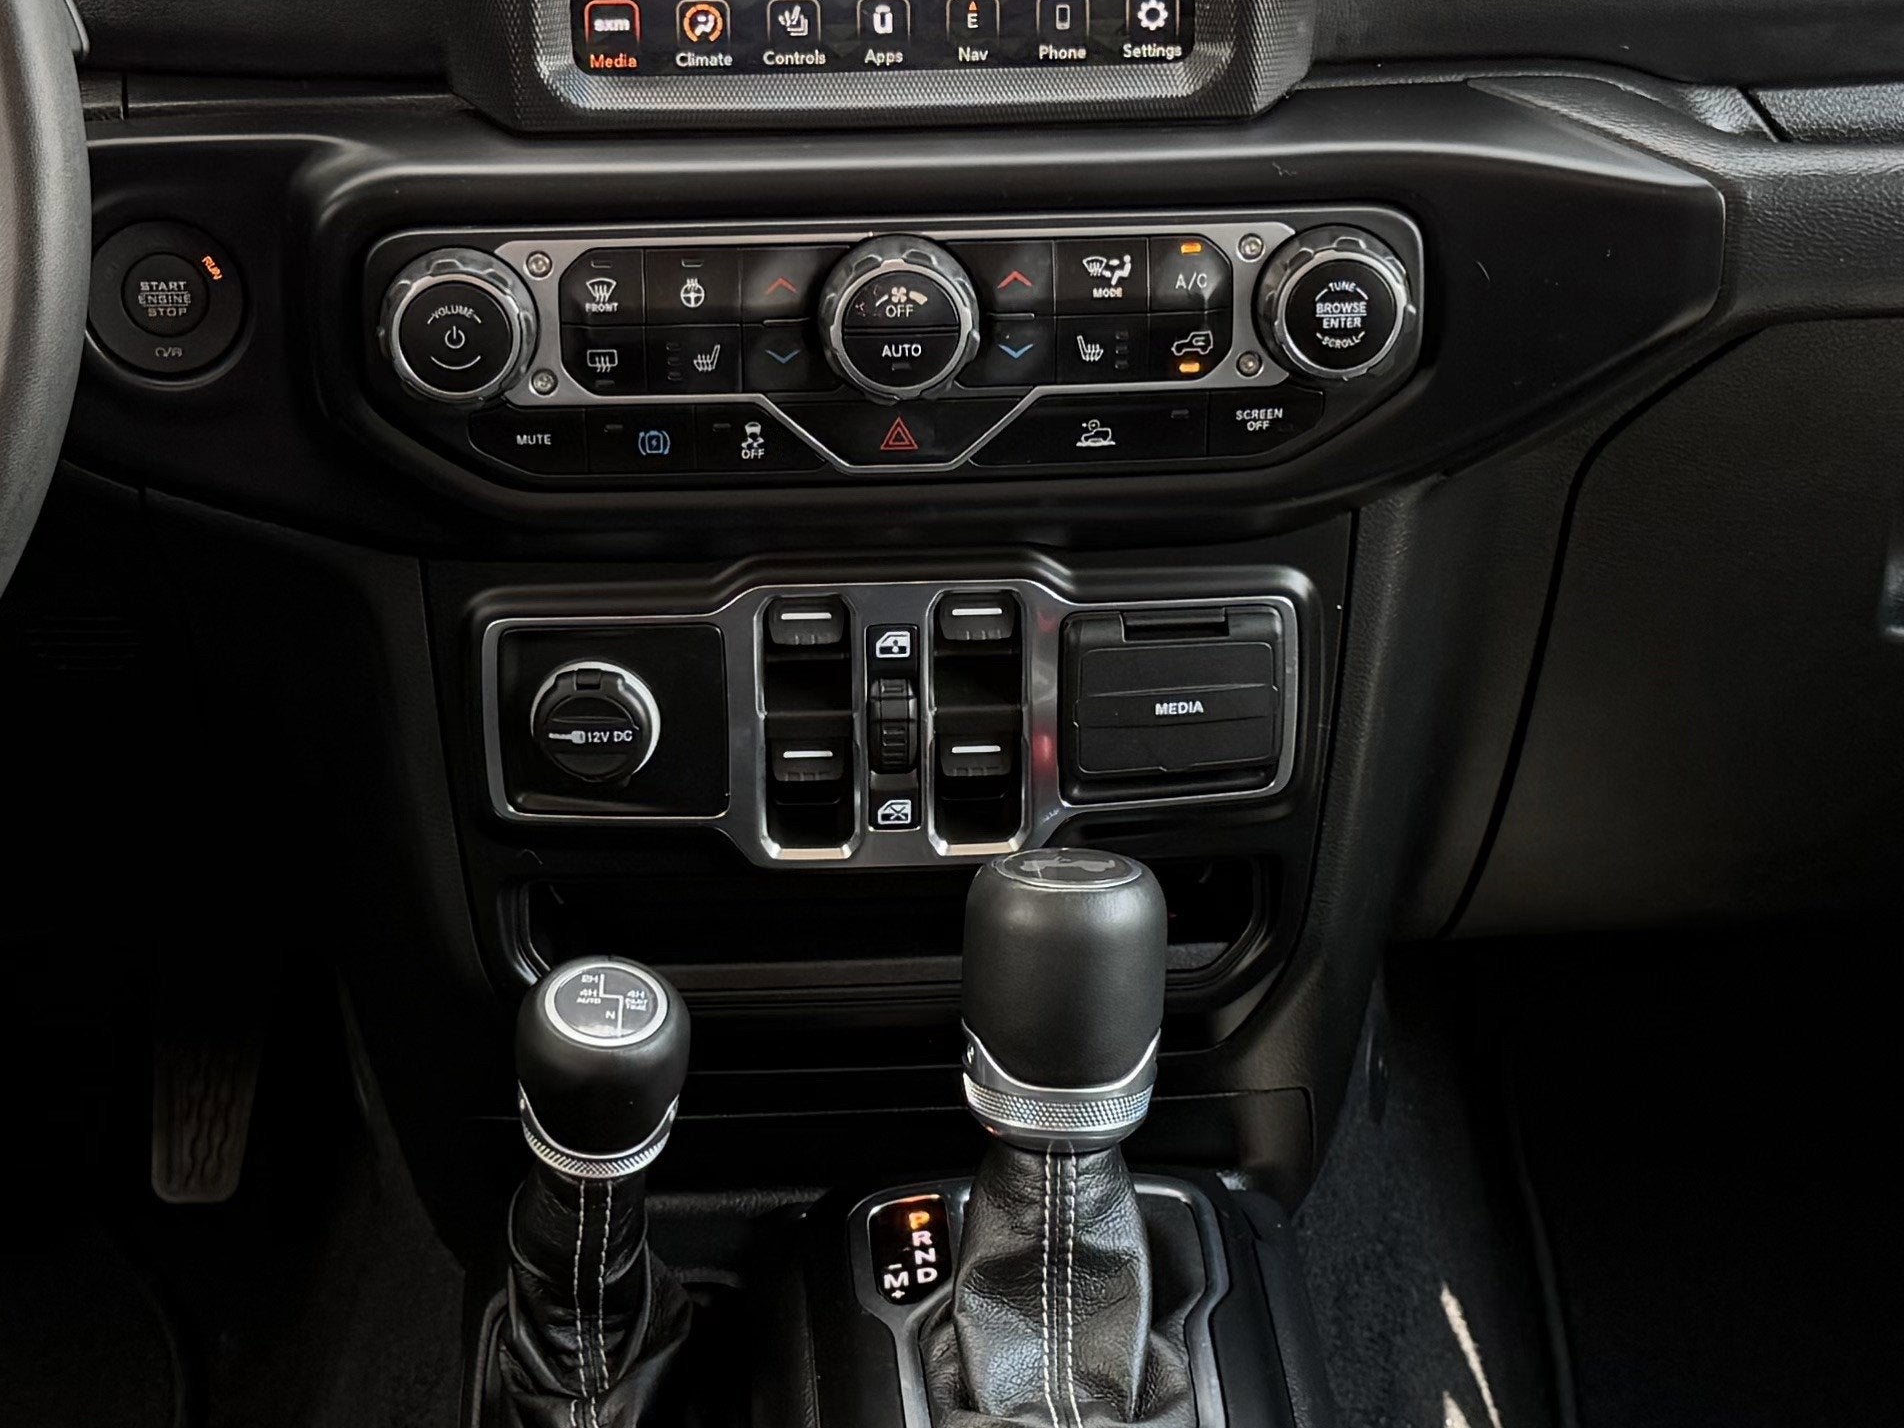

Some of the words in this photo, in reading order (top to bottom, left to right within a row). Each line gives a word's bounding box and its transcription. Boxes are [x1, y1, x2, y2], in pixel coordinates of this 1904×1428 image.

[675, 51, 733, 67] Climate
[763, 49, 826, 66] Controls
[864, 49, 904, 64] Apps
[959, 47, 988, 62] Nav
[1039, 45, 1086, 61] Phone
[1122, 43, 1182, 60] Settings
[590, 53, 638, 69] Media
[201, 255, 223, 282] RUN
[140, 280, 187, 292] START
[1175, 272, 1208, 290] A/C
[1328, 280, 1356, 293] TUNE
[137, 293, 192, 305] ENGINE
[1093, 287, 1123, 299] MODE
[147, 306, 188, 318] STOP
[431, 305, 474, 320] VOLUME
[585, 301, 618, 314] FRONT
[885, 304, 915, 319] OFF
[1315, 301, 1367, 316] BROWSE
[1322, 316, 1362, 330] ENTER
[1321, 333, 1362, 350] SCROLL
[881, 343, 922, 360] AUTO
[1235, 407, 1284, 422] SCREEN
[1246, 419, 1271, 433] OFF
[516, 433, 552, 447] MUTE
[741, 446, 765, 460] OFF
[1154, 699, 1205, 716] MEDIA
[586, 730, 611, 744] 12V
[614, 729, 633, 743] DC
[605, 1010, 616, 1020] N
[909, 1211, 930, 1230] P
[912, 1230, 933, 1247] R
[914, 1247, 937, 1265] N
[883, 1271, 910, 1289] M
[916, 1267, 938, 1284] D
